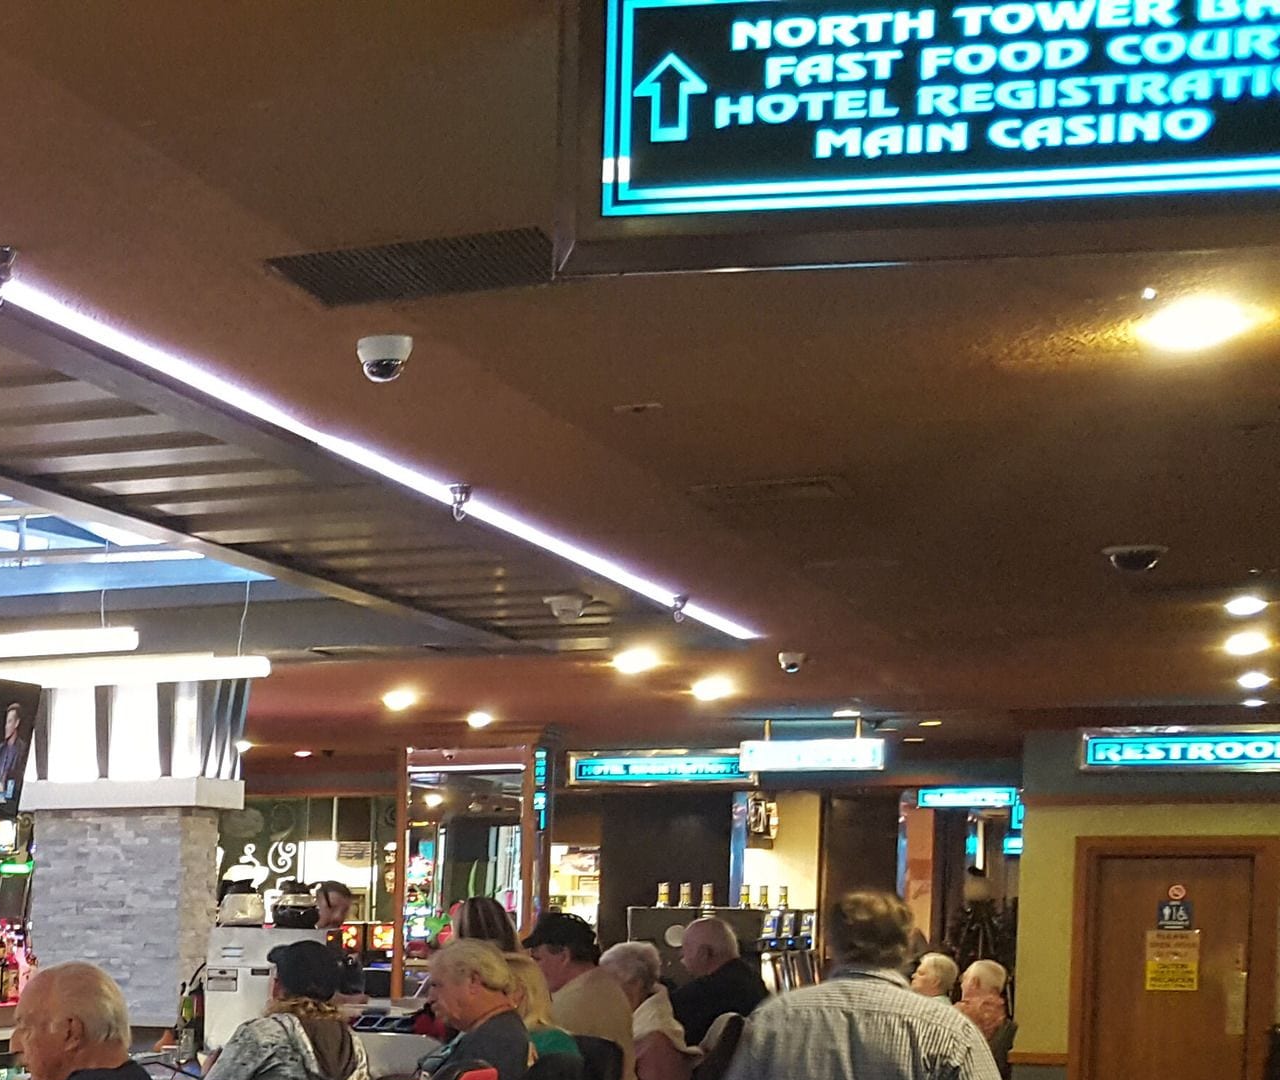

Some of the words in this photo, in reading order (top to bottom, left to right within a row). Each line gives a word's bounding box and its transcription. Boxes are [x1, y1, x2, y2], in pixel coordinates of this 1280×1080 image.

[731, 8, 937, 51] NORTH
[952, 0, 1182, 35] TOWER
[765, 50, 903, 89] FAST
[920, 38, 1090, 82] FOOD
[714, 90, 898, 129] HOTEL
[916, 64, 1280, 118] REGISTRATI
[814, 119, 969, 158] MAIN
[988, 108, 1216, 150] CASINO
[1095, 740, 1280, 762] RESTROO
